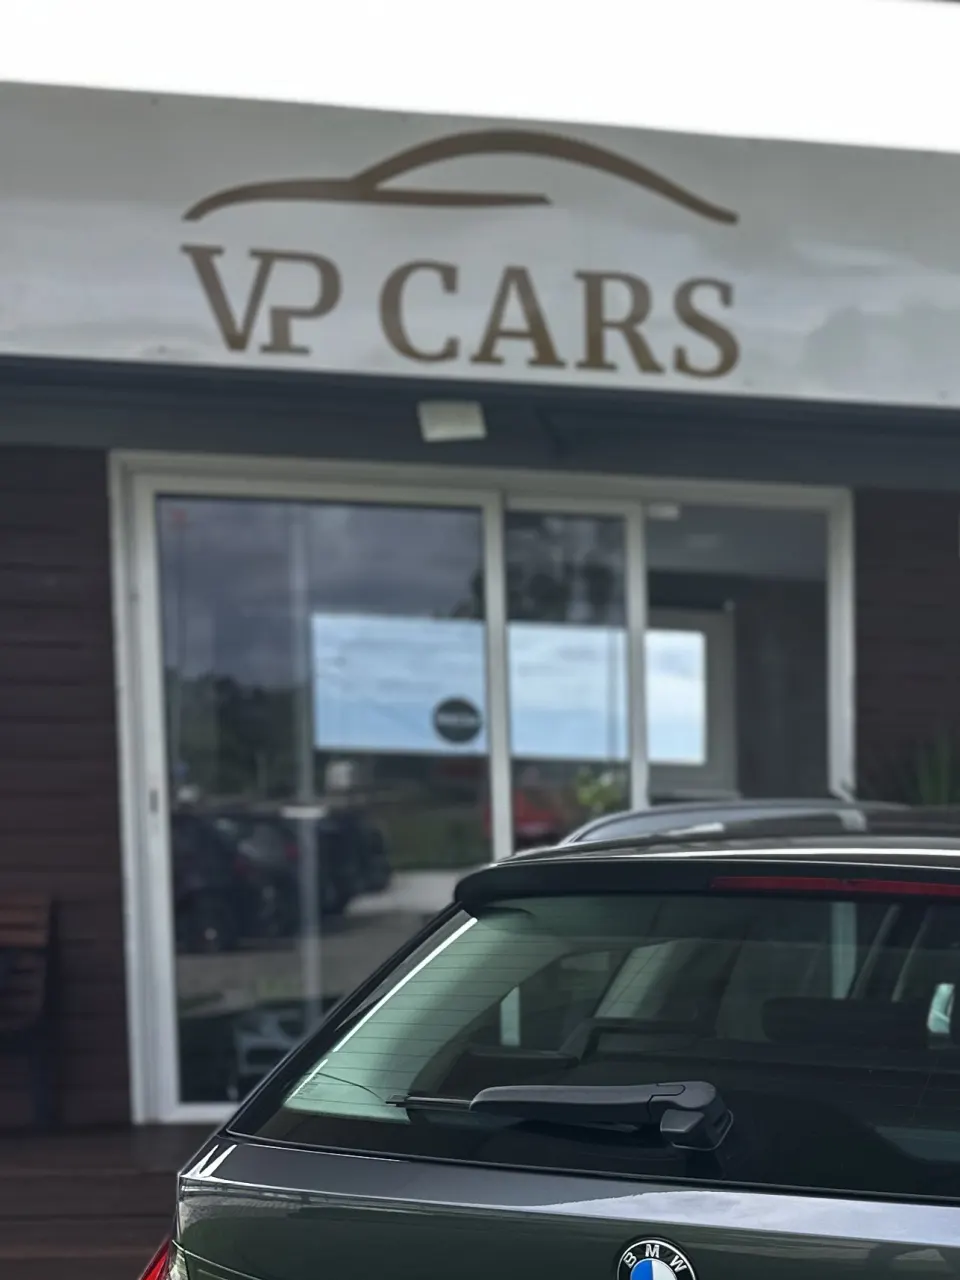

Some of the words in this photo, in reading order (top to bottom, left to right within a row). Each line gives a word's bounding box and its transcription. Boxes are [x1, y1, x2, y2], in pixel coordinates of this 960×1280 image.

[180, 243, 344, 357] VP
[377, 258, 741, 381] CARS
[623, 1243, 688, 1273] BMW
